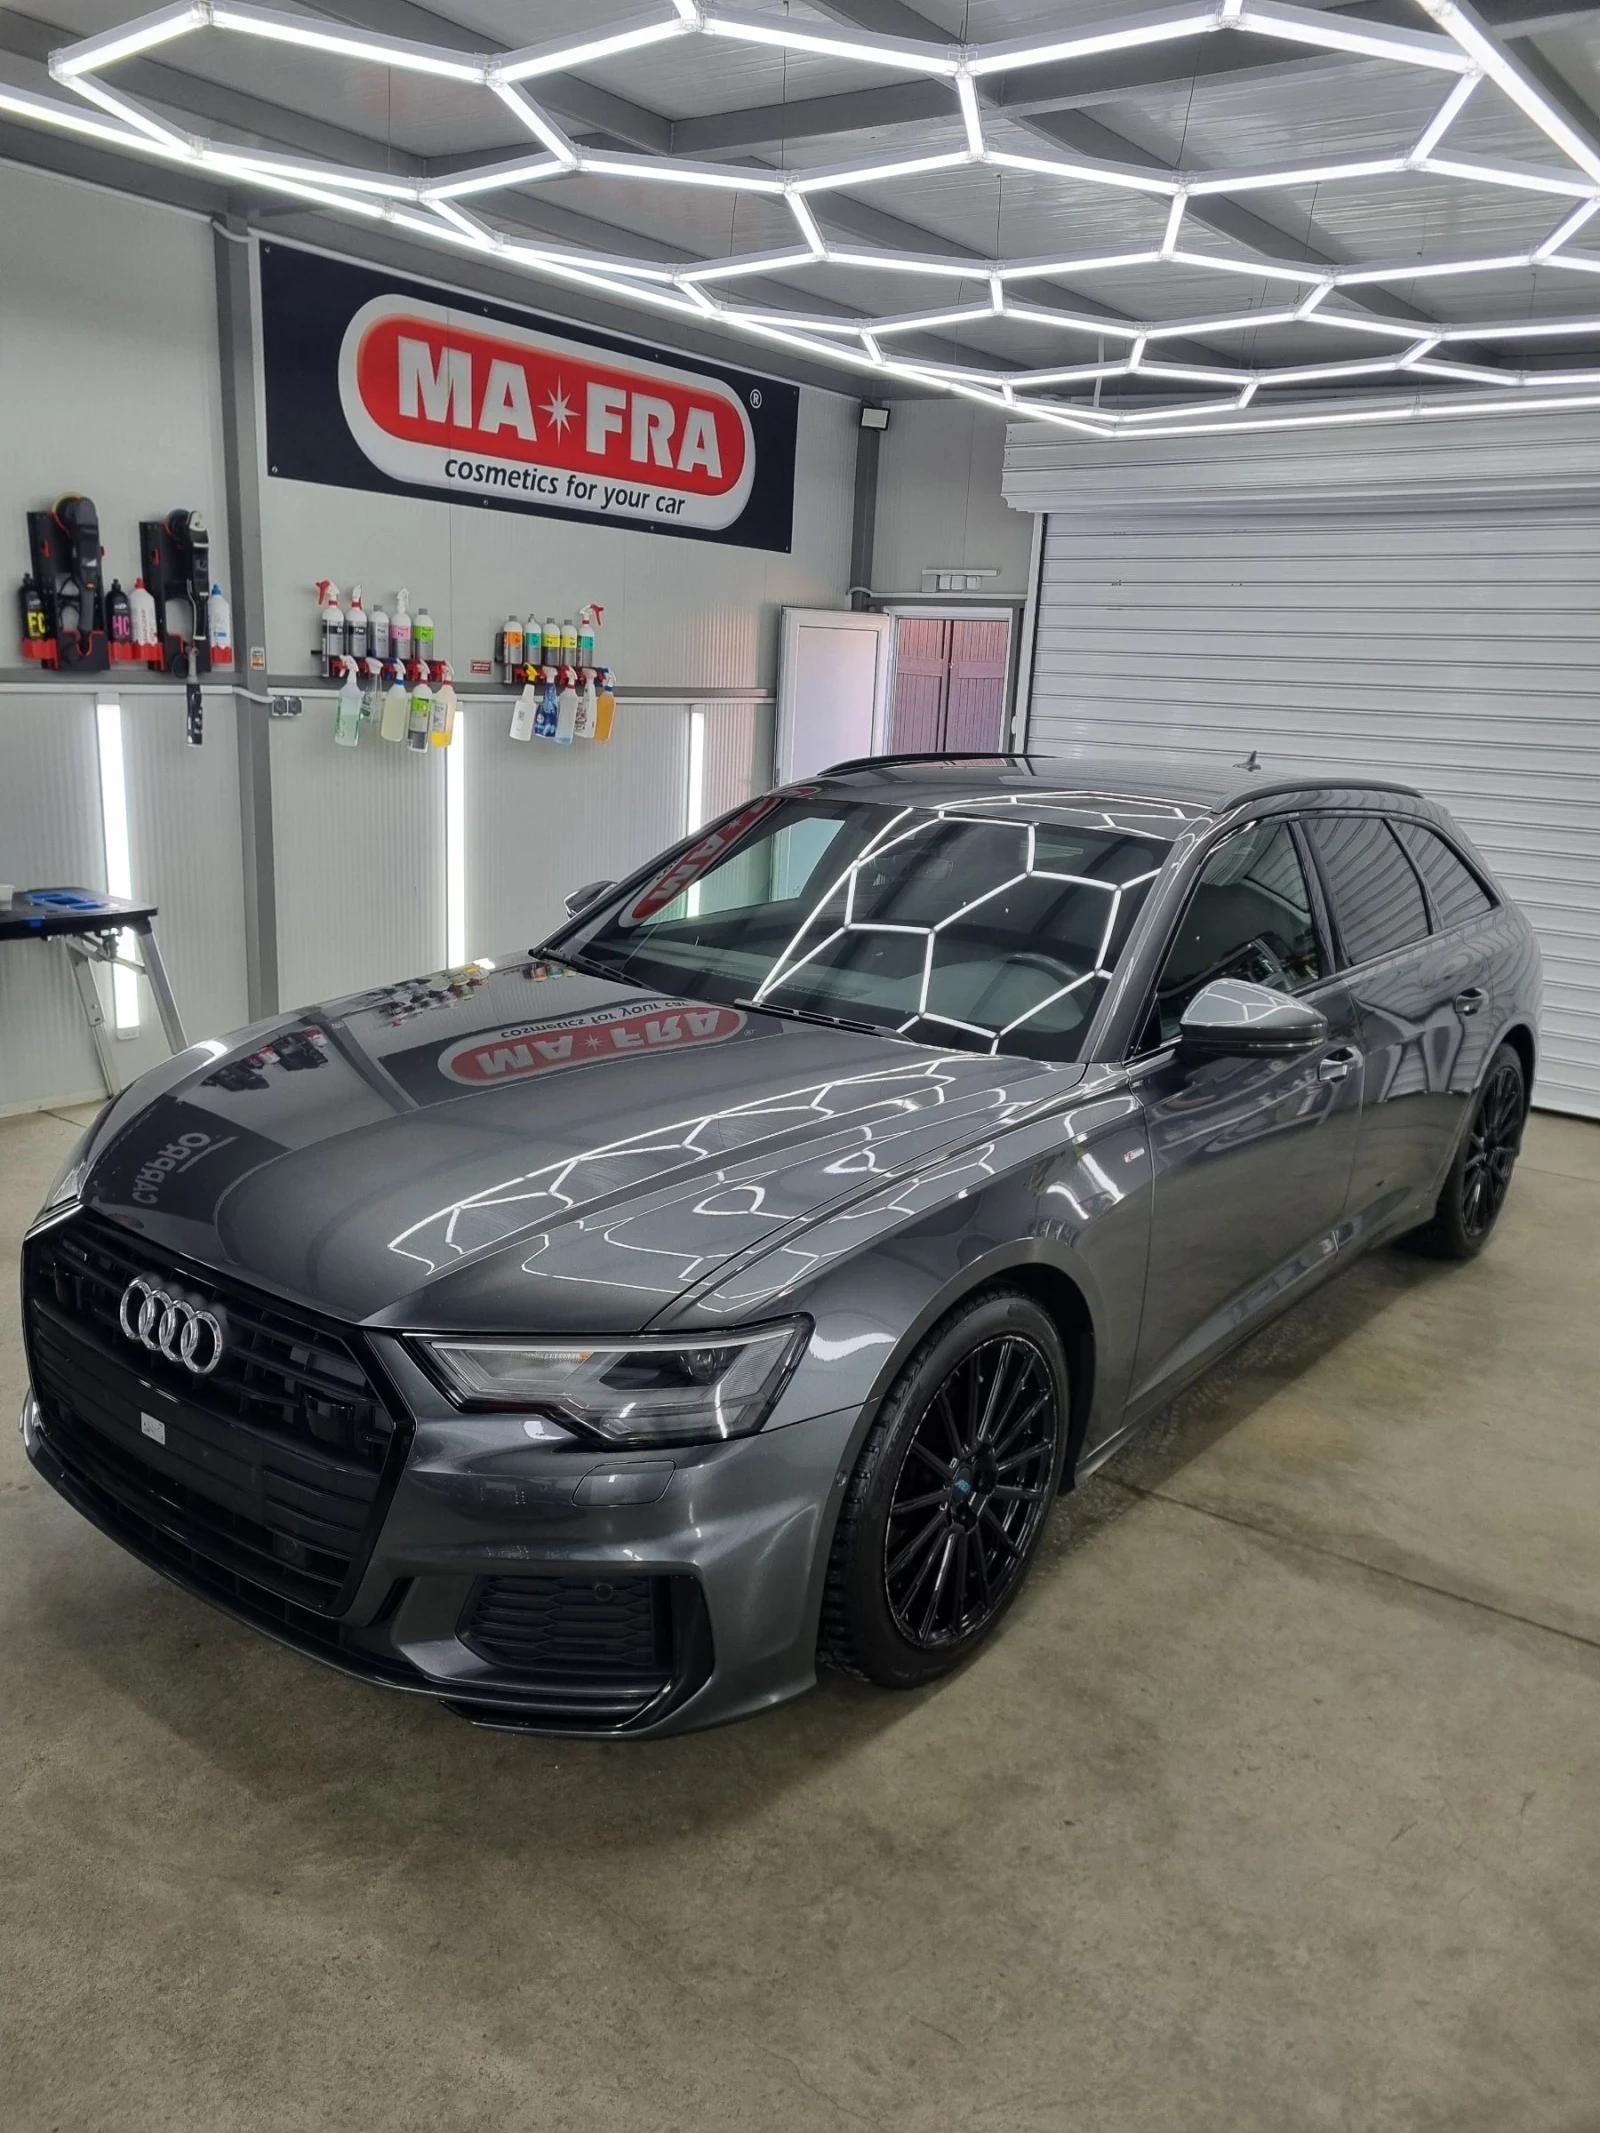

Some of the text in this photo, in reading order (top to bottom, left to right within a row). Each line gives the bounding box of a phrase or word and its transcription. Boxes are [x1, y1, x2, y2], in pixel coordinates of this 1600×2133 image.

[397, 335, 538, 442] MA
[585, 381, 723, 479] FRA
[444, 457, 686, 515] cosmetics for your car
[112, 615, 130, 637] HC
